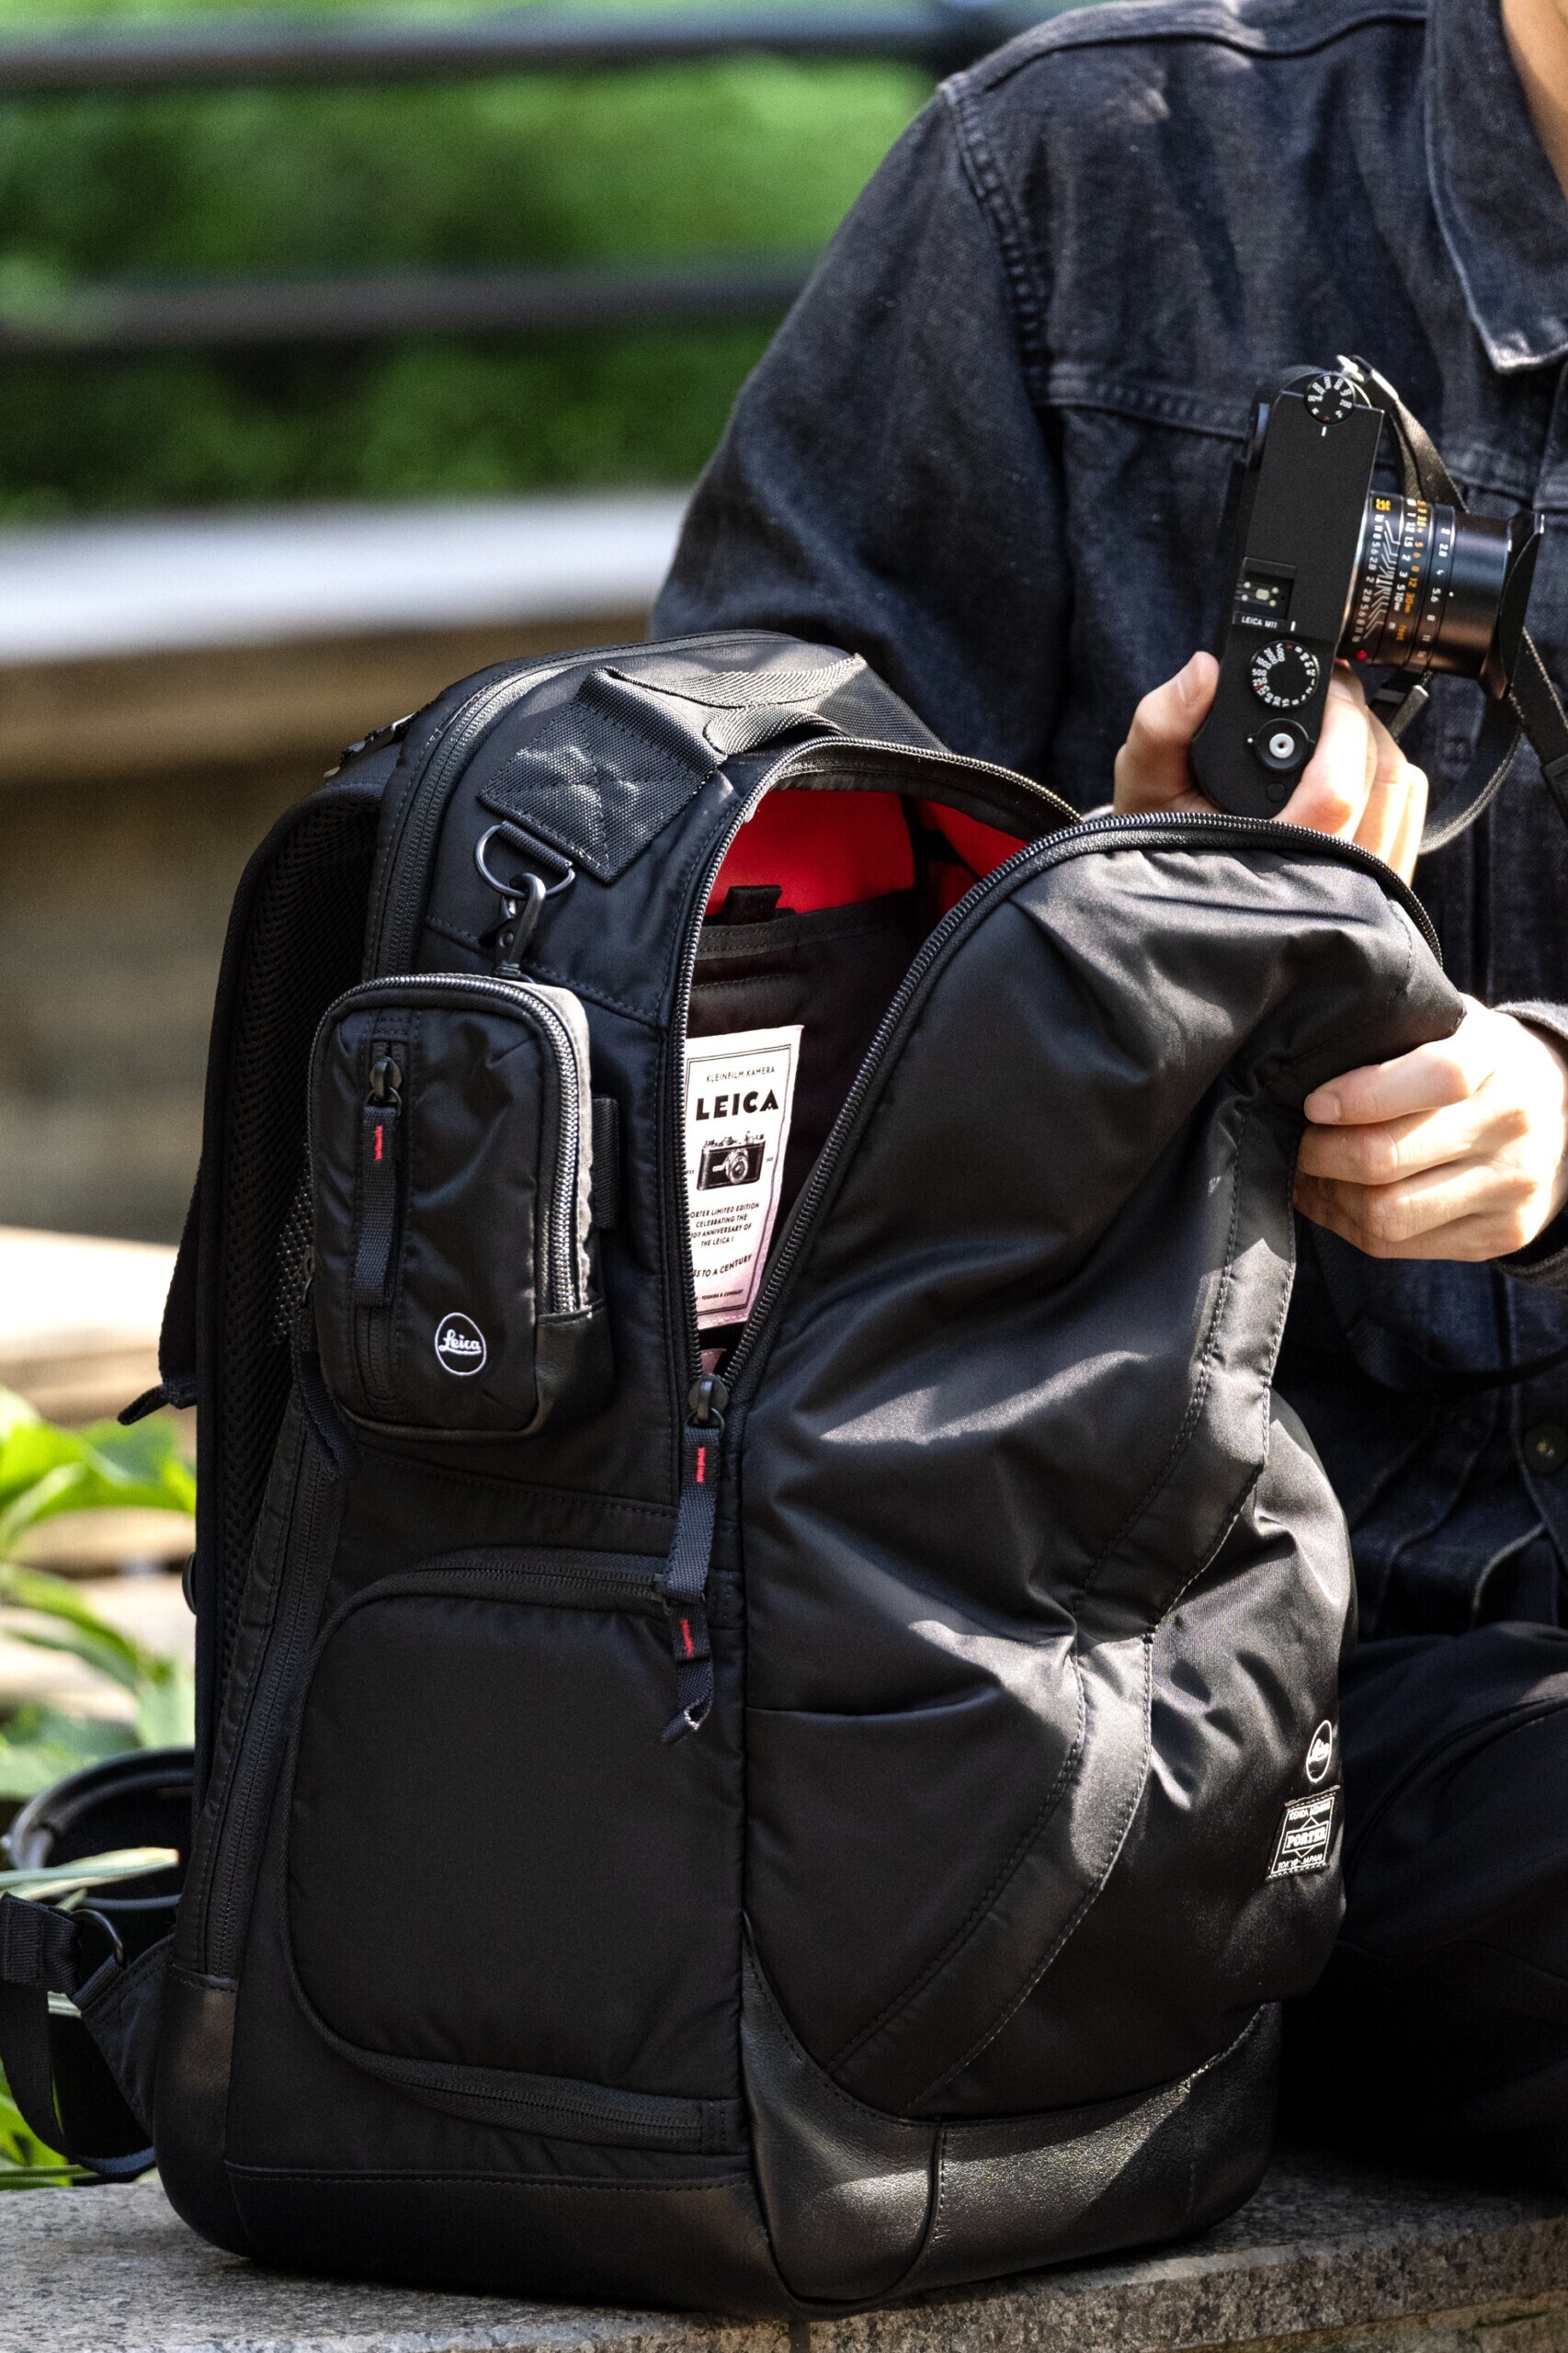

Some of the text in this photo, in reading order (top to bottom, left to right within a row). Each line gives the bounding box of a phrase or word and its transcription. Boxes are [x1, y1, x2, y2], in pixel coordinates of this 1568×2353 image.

[1399, 570, 1408, 578] 3
[1241, 615, 1278, 630] LEICA M11
[1256, 655, 1273, 670] 1000
[1263, 647, 1278, 665] 2000
[1251, 668, 1267, 676] 500
[1252, 676, 1268, 687] 250
[696, 1088, 779, 1121] LEICA
[689, 1202, 760, 1219] ORTER LIMITED EDITION
[696, 1213, 747, 1228] CELEBRATING THE
[702, 1224, 742, 1237] ANNIVERSARY
[744, 1222, 753, 1231] OF
[712, 1237, 730, 1246] LEICA
[702, 1268, 711, 1278] TO
[720, 1254, 753, 1274] CENTURY
[438, 1329, 482, 1355] Leica
[1287, 1826, 1327, 1848] PORTER
